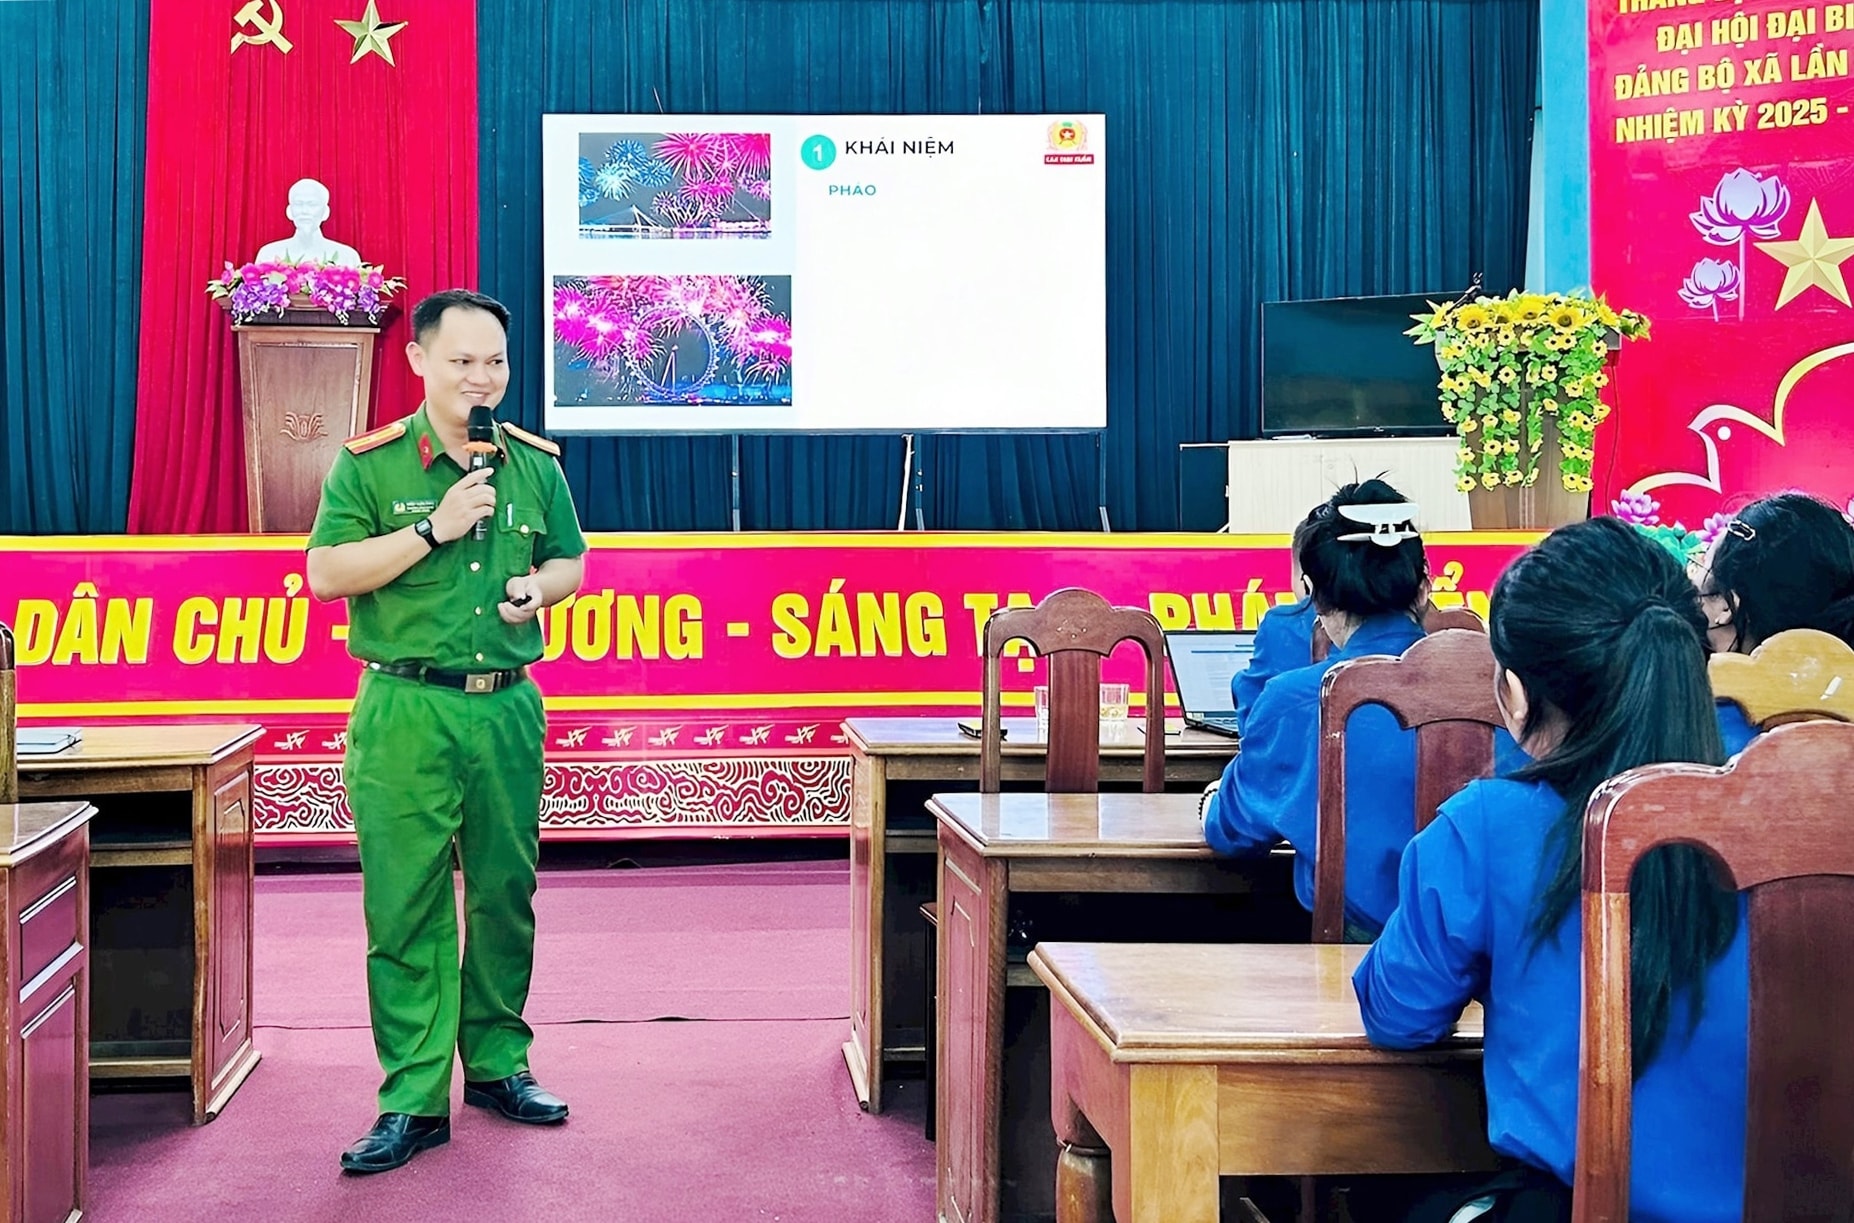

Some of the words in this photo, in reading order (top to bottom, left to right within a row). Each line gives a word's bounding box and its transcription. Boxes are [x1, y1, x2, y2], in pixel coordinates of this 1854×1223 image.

[1656, 21, 1703, 55] ĐẠI
[1711, 11, 1759, 48] HỘI
[1766, 7, 1816, 42] ĐẠI
[1614, 64, 1690, 100] ĐẢNG
[1697, 57, 1735, 94] BỘ
[1743, 52, 1783, 86] XÃ
[1790, 42, 1849, 81] LẦN
[1615, 107, 1705, 143] NHIỆM
[1713, 99, 1749, 133] KỲ
[1757, 97, 1828, 129] 2025
[812, 143, 823, 162] 1
[845, 136, 895, 155] KHÁI
[903, 136, 954, 158] NIỆM
[14, 581, 154, 665] DÂN
[171, 573, 310, 664] CHỦ
[536, 588, 703, 662] ƯƠNG
[726, 622, 750, 637] -
[771, 578, 948, 658] SÁNG
[963, 592, 1036, 673] TẠ
[1149, 578, 1297, 631] PHÁ
